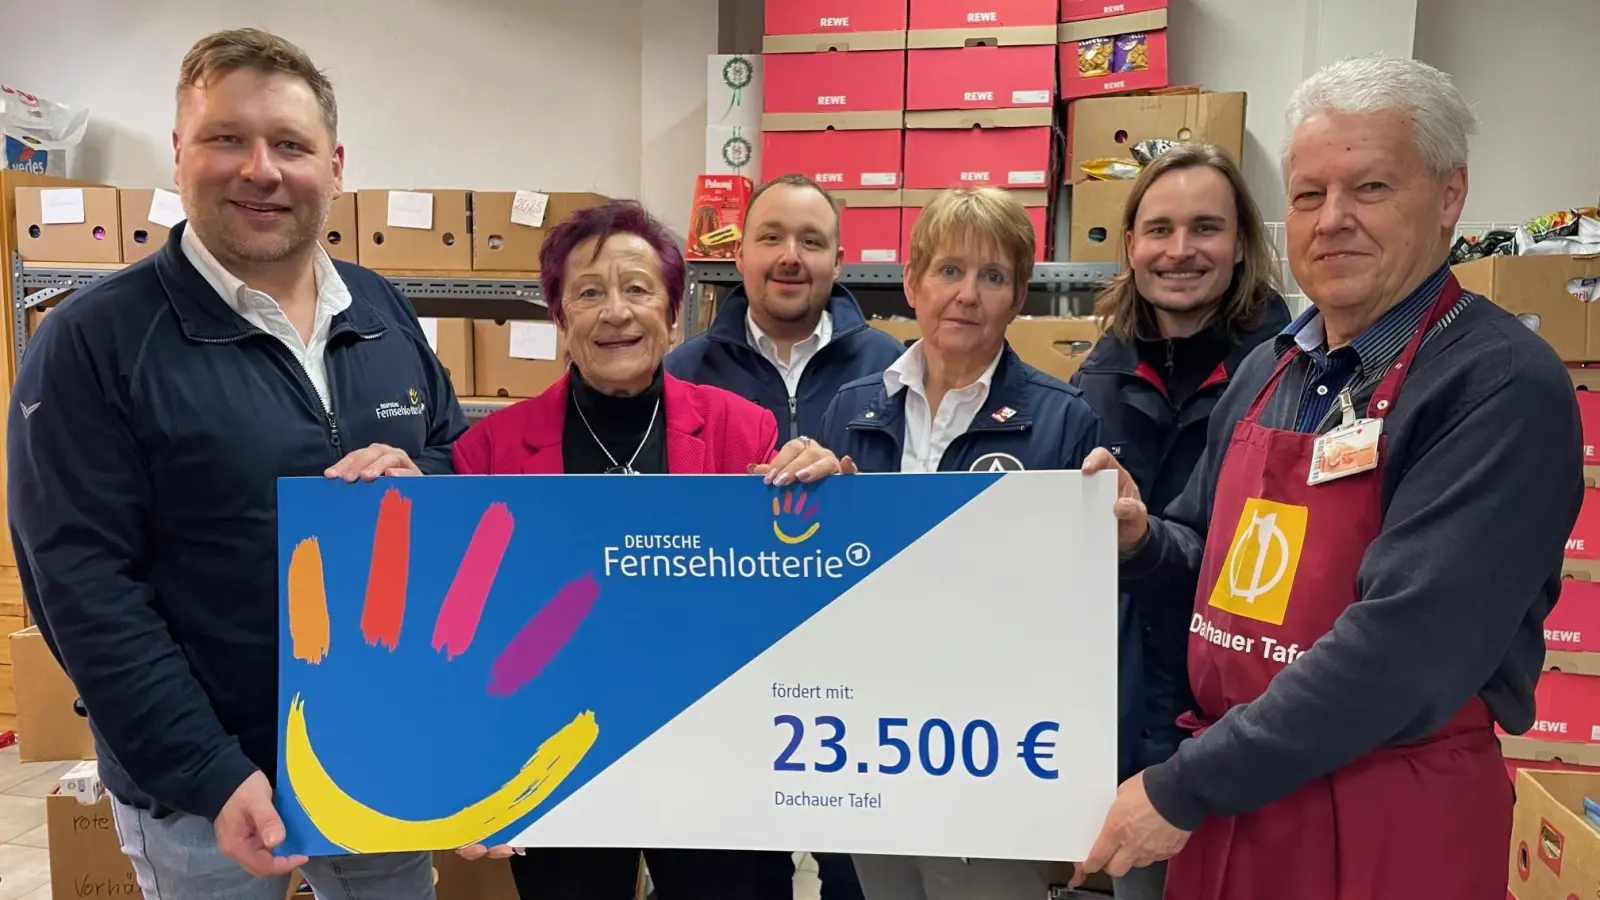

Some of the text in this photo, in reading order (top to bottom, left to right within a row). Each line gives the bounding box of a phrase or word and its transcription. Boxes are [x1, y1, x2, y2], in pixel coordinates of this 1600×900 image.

[1103, 4, 1125, 14] REWE
[820, 16, 849, 27] REWE
[967, 11, 997, 22] REWE
[1103, 80, 1125, 90] REWE
[817, 95, 846, 105] REWE
[963, 91, 994, 101] REWE
[814, 173, 844, 183] REWE
[960, 171, 990, 181] REWE
[624, 534, 701, 549] DEUTSCHE
[1564, 539, 1585, 550] WE
[604, 547, 843, 579] Fernsehlotterie
[1543, 629, 1581, 643] REWE
[1261, 637, 1306, 664] Taf
[771, 682, 854, 700] fördert mit:
[773, 714, 1060, 780] 23.500 €
[774, 790, 882, 809] Dachauer Tafel
[73, 814, 109, 834] rote
[74, 872, 142, 898] Vorhä
